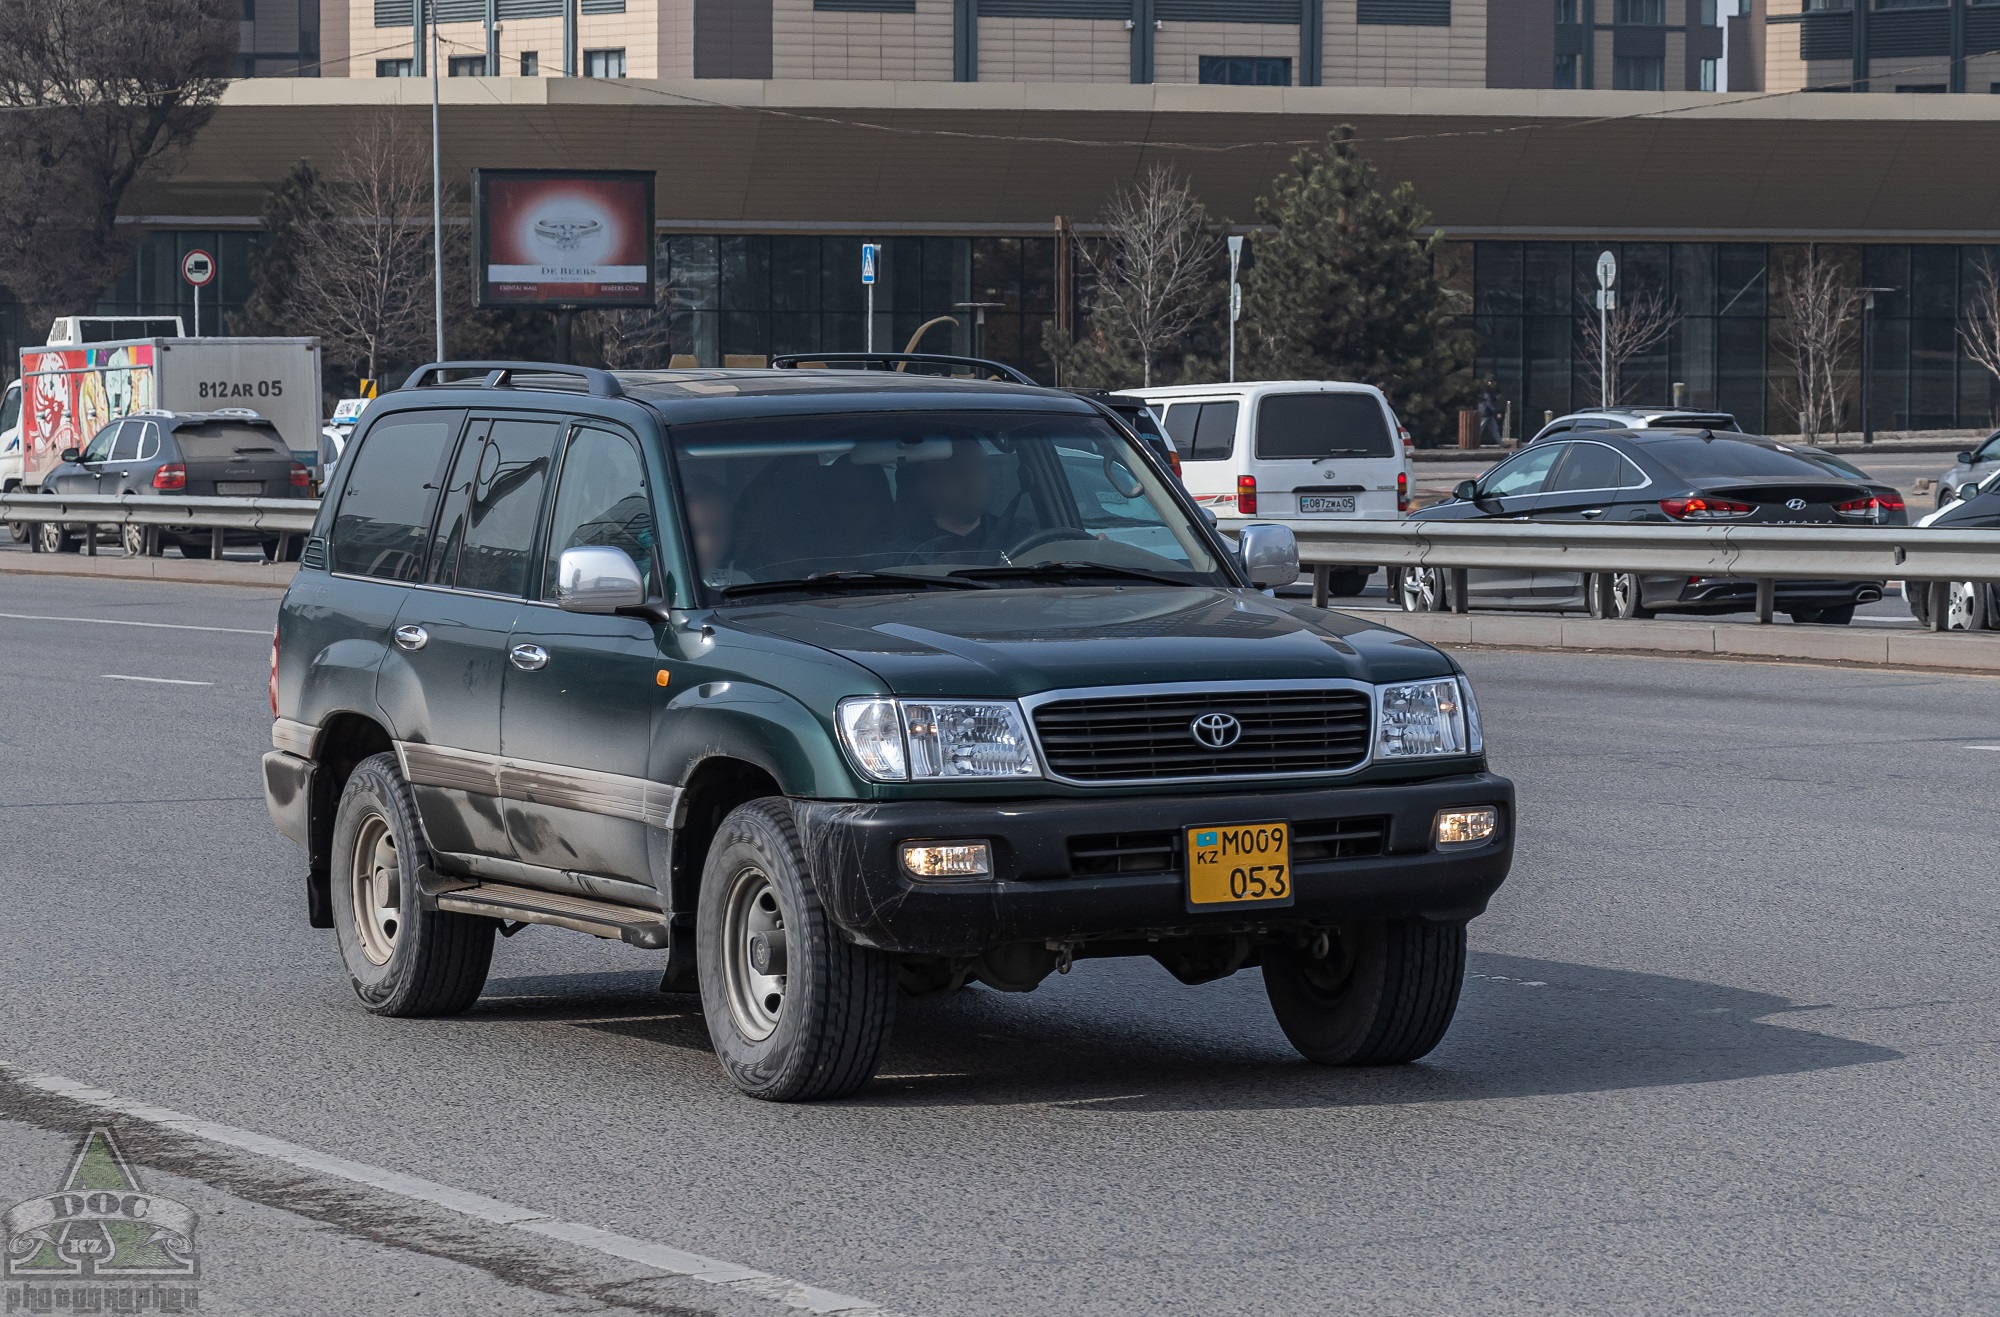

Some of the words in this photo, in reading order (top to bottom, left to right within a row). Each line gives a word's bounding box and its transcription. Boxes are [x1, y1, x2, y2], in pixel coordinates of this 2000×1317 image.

[541, 267, 557, 275] DE
[560, 267, 597, 275] BEERS
[258, 380, 282, 397] 05
[1222, 827, 1283, 856] M009
[1197, 850, 1218, 865] KZ
[1229, 865, 1286, 899] 053
